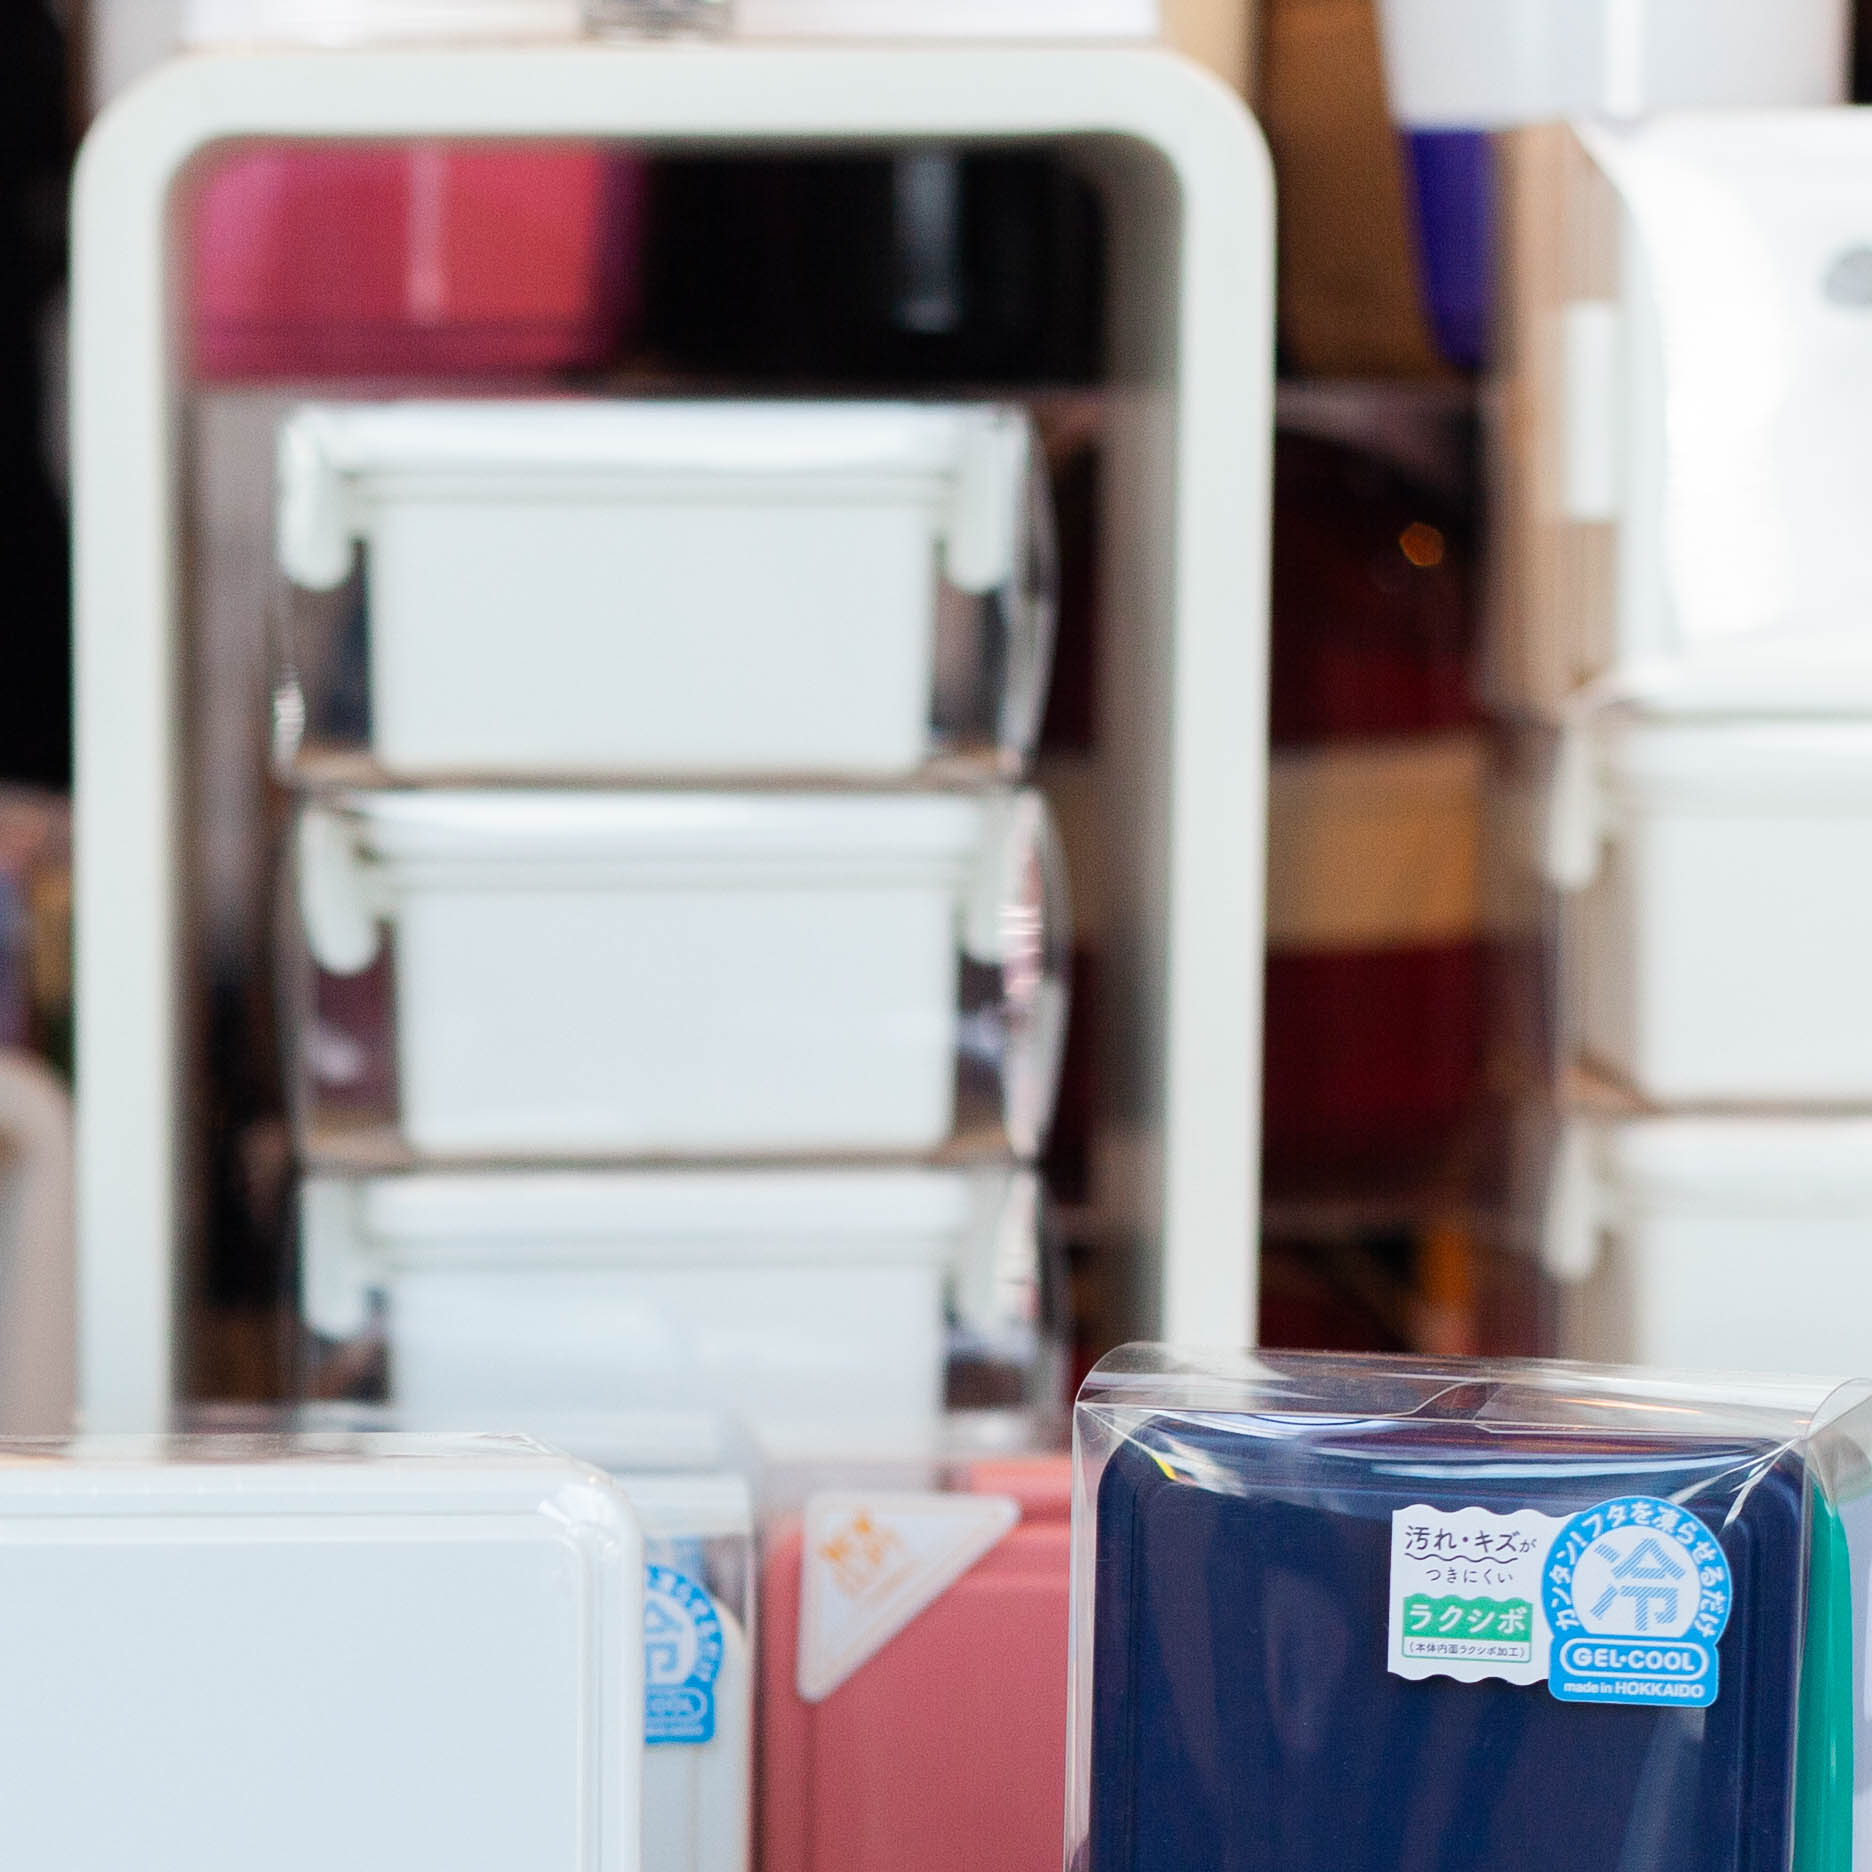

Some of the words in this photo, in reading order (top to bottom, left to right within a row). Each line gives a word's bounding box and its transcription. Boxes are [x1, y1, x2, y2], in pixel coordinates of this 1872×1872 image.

[1404, 1525, 1538, 1554] 汚れ・キズが
[1425, 1567, 1514, 1585] つきにくい
[1590, 1538, 1687, 1632] 冷
[1408, 1603, 1528, 1635] ラクシボ
[1564, 1681, 1599, 1693] made
[1601, 1682, 1613, 1694] in
[1615, 1681, 1705, 1699] HOKKAIDO
